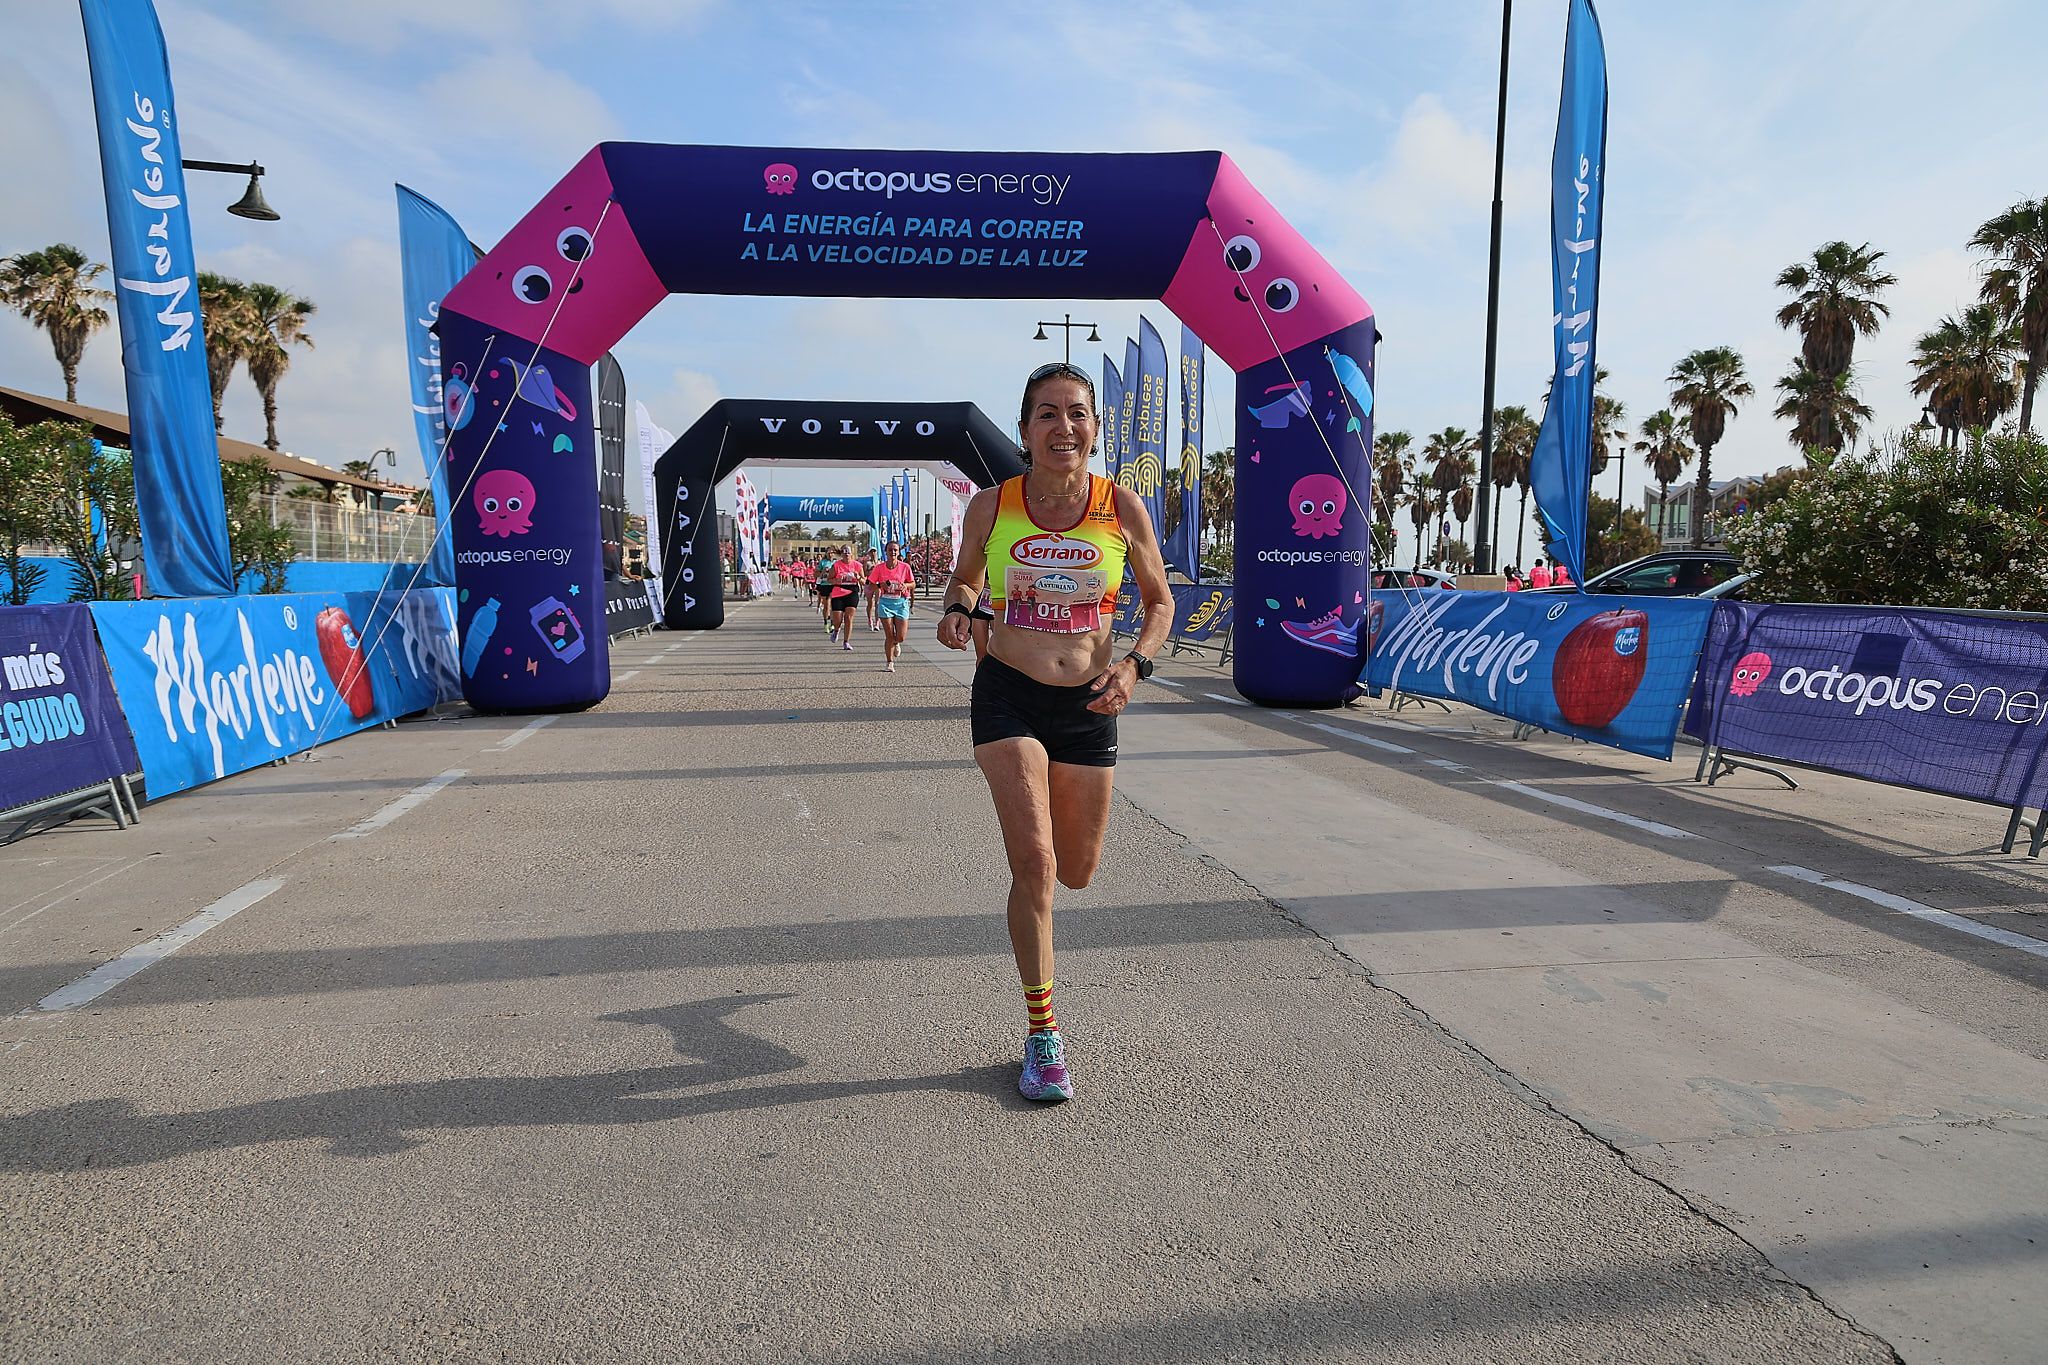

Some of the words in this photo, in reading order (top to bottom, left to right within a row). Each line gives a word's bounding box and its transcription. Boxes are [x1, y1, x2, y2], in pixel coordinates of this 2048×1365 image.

[811, 168, 951, 199] octopus
[956, 174, 1071, 205] energy
[743, 213, 776, 233] LA
[783, 211, 896, 237] ENERGÍA
[903, 217, 973, 238] PARA
[980, 219, 1084, 240] CORRER
[740, 243, 759, 260] A
[766, 244, 799, 262] LA
[807, 245, 953, 266] VELOCIDAD
[959, 248, 994, 266] DE
[999, 249, 1031, 266] LA
[1038, 250, 1088, 267] LUZ
[760, 418, 935, 436] VOLVO
[799, 499, 845, 518] Marlene
[457, 550, 512, 567] octopus
[513, 548, 572, 566] energy
[677, 485, 696, 612] VOLVO
[1018, 542, 1097, 561] Serrano
[1257, 549, 1322, 566] octopus
[1323, 550, 1366, 566] energy
[1037, 603, 1071, 619] 016
[1376, 593, 1540, 701] Marlene
[2, 643, 65, 691] más
[142, 607, 324, 779] Marlene
[1779, 665, 1943, 716] octopus
